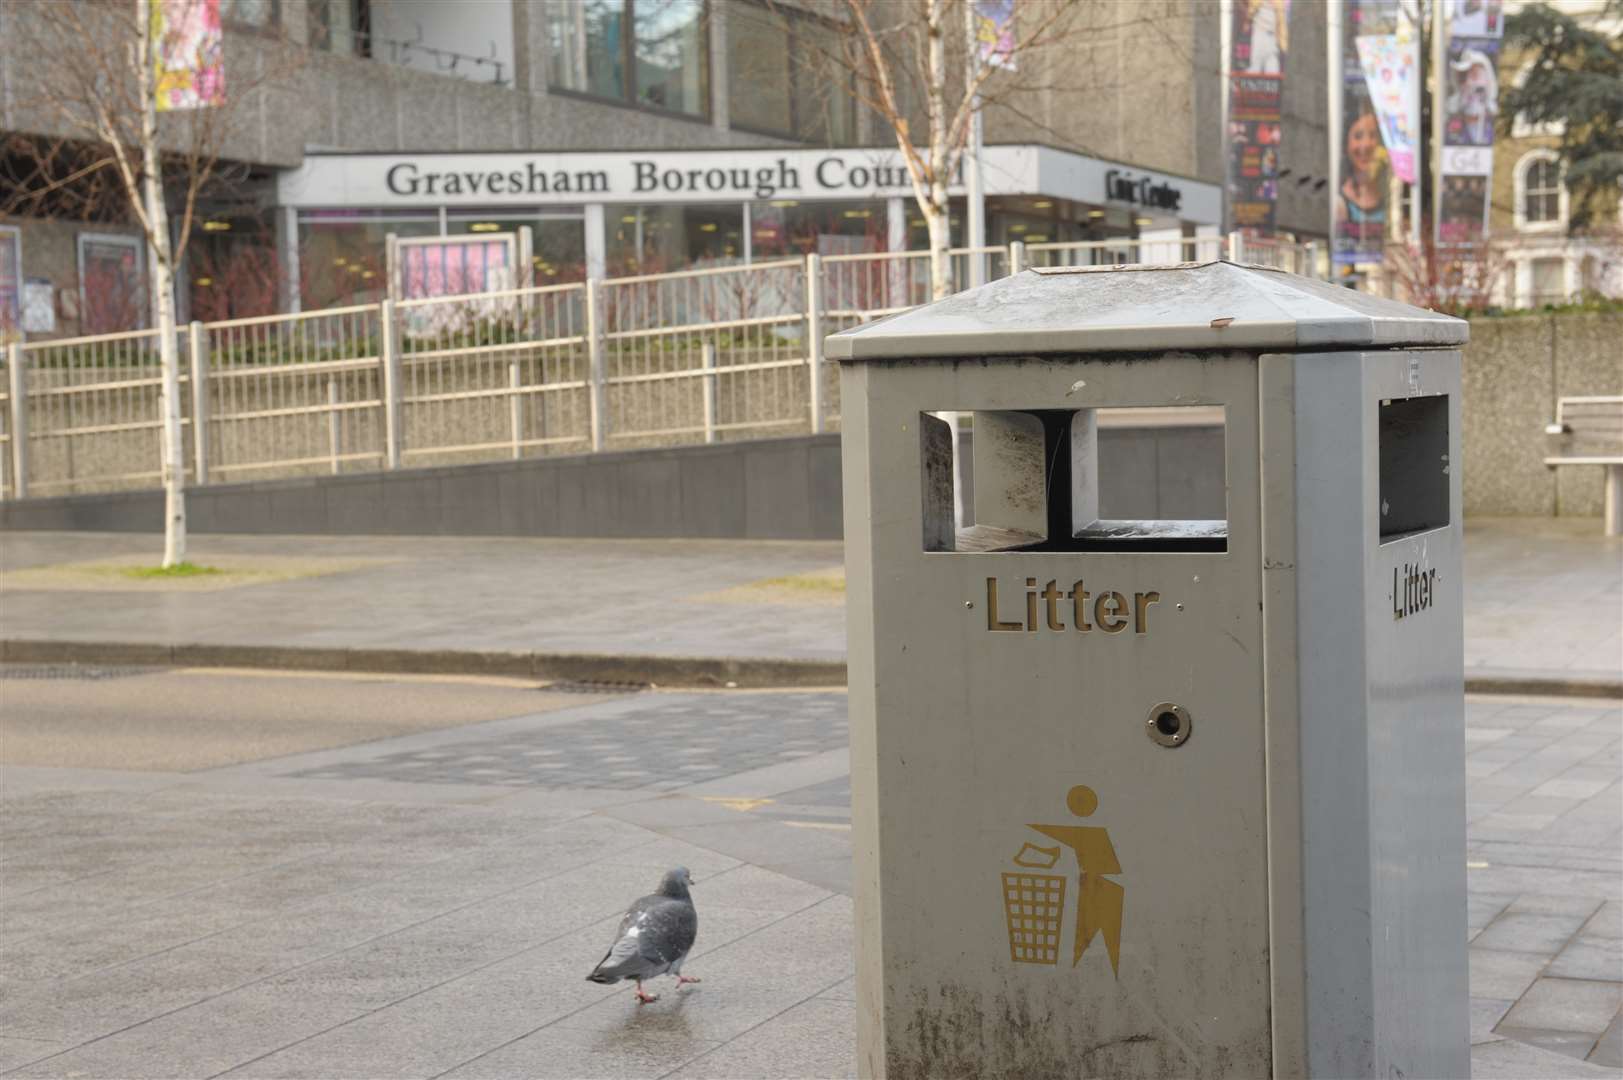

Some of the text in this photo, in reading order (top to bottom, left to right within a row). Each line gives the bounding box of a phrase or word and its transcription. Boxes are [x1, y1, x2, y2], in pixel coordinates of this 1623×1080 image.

[386, 152, 965, 198] Gravesham Borough Counl
[986, 577, 1160, 634] Litter
[1393, 561, 1436, 621] Litter
